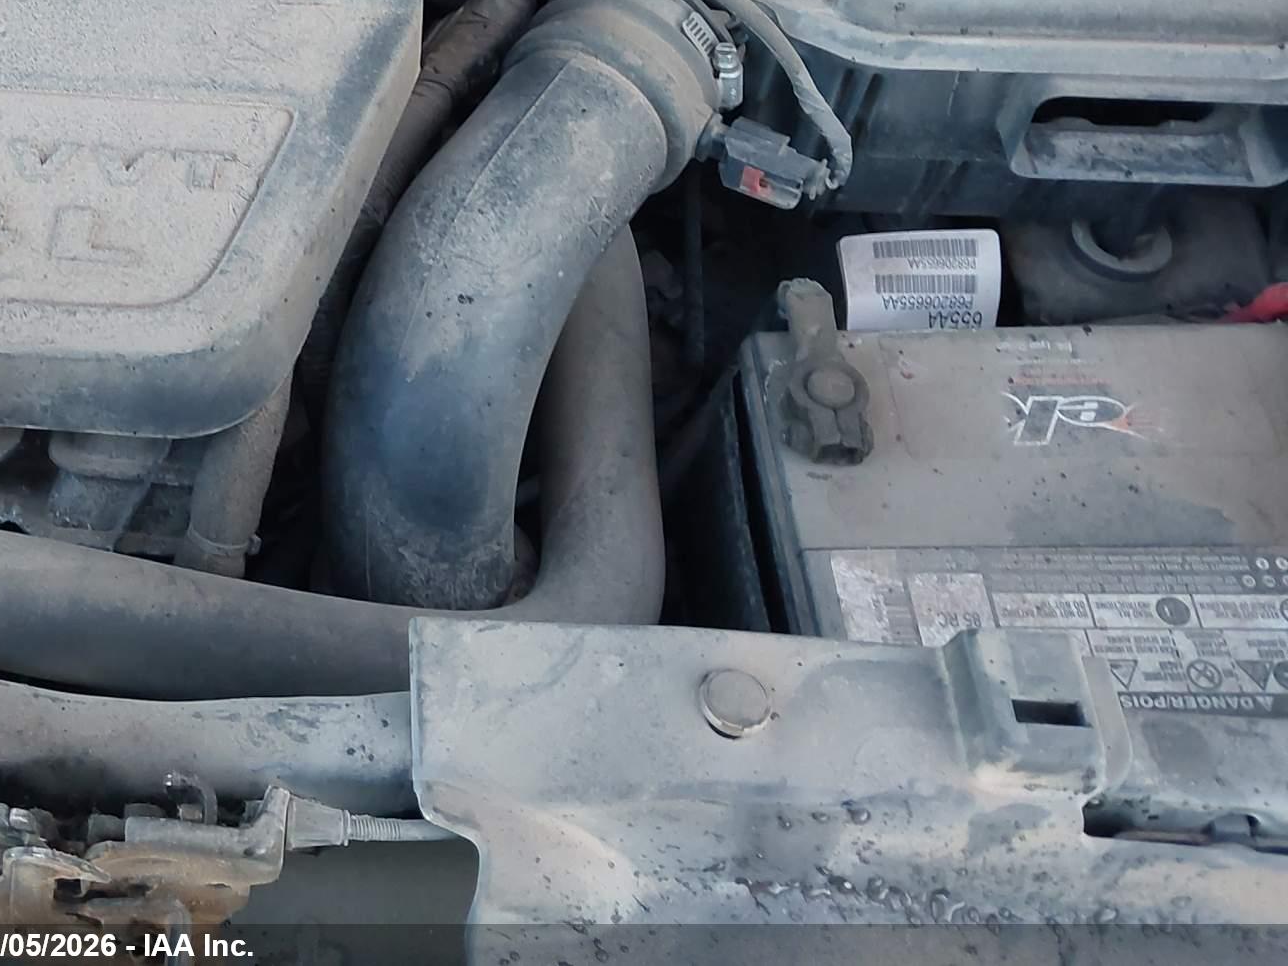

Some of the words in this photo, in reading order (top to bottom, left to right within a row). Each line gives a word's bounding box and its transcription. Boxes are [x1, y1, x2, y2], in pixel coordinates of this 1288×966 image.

[13, 139, 242, 191] VVT
[882, 294, 974, 311] P68206655AA
[928, 310, 983, 329] 655AA
